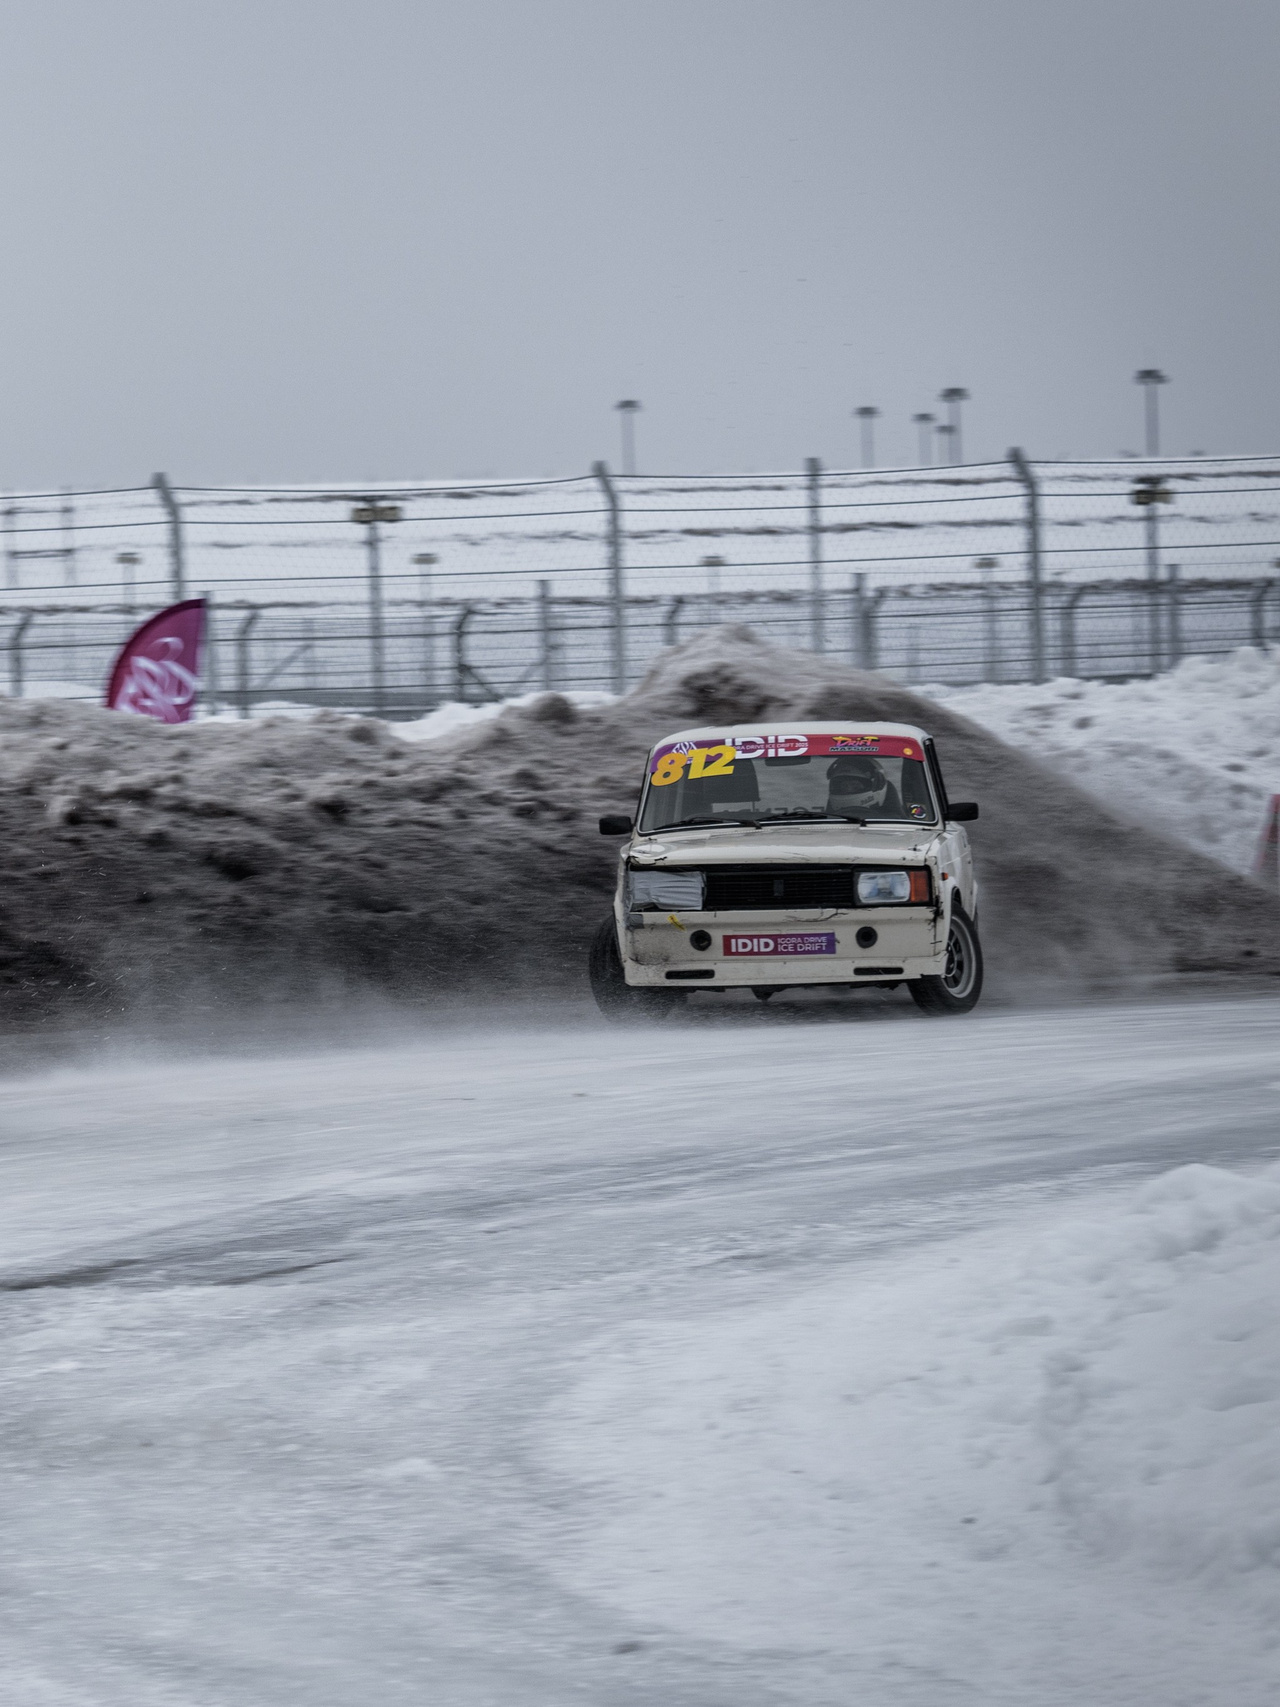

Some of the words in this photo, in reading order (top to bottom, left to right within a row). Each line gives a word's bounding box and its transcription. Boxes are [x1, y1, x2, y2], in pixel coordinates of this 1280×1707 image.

[651, 745, 737, 786] 812
[730, 938, 775, 953] IDID
[778, 943, 795, 952] ICE
[797, 942, 827, 951] DRIFT
